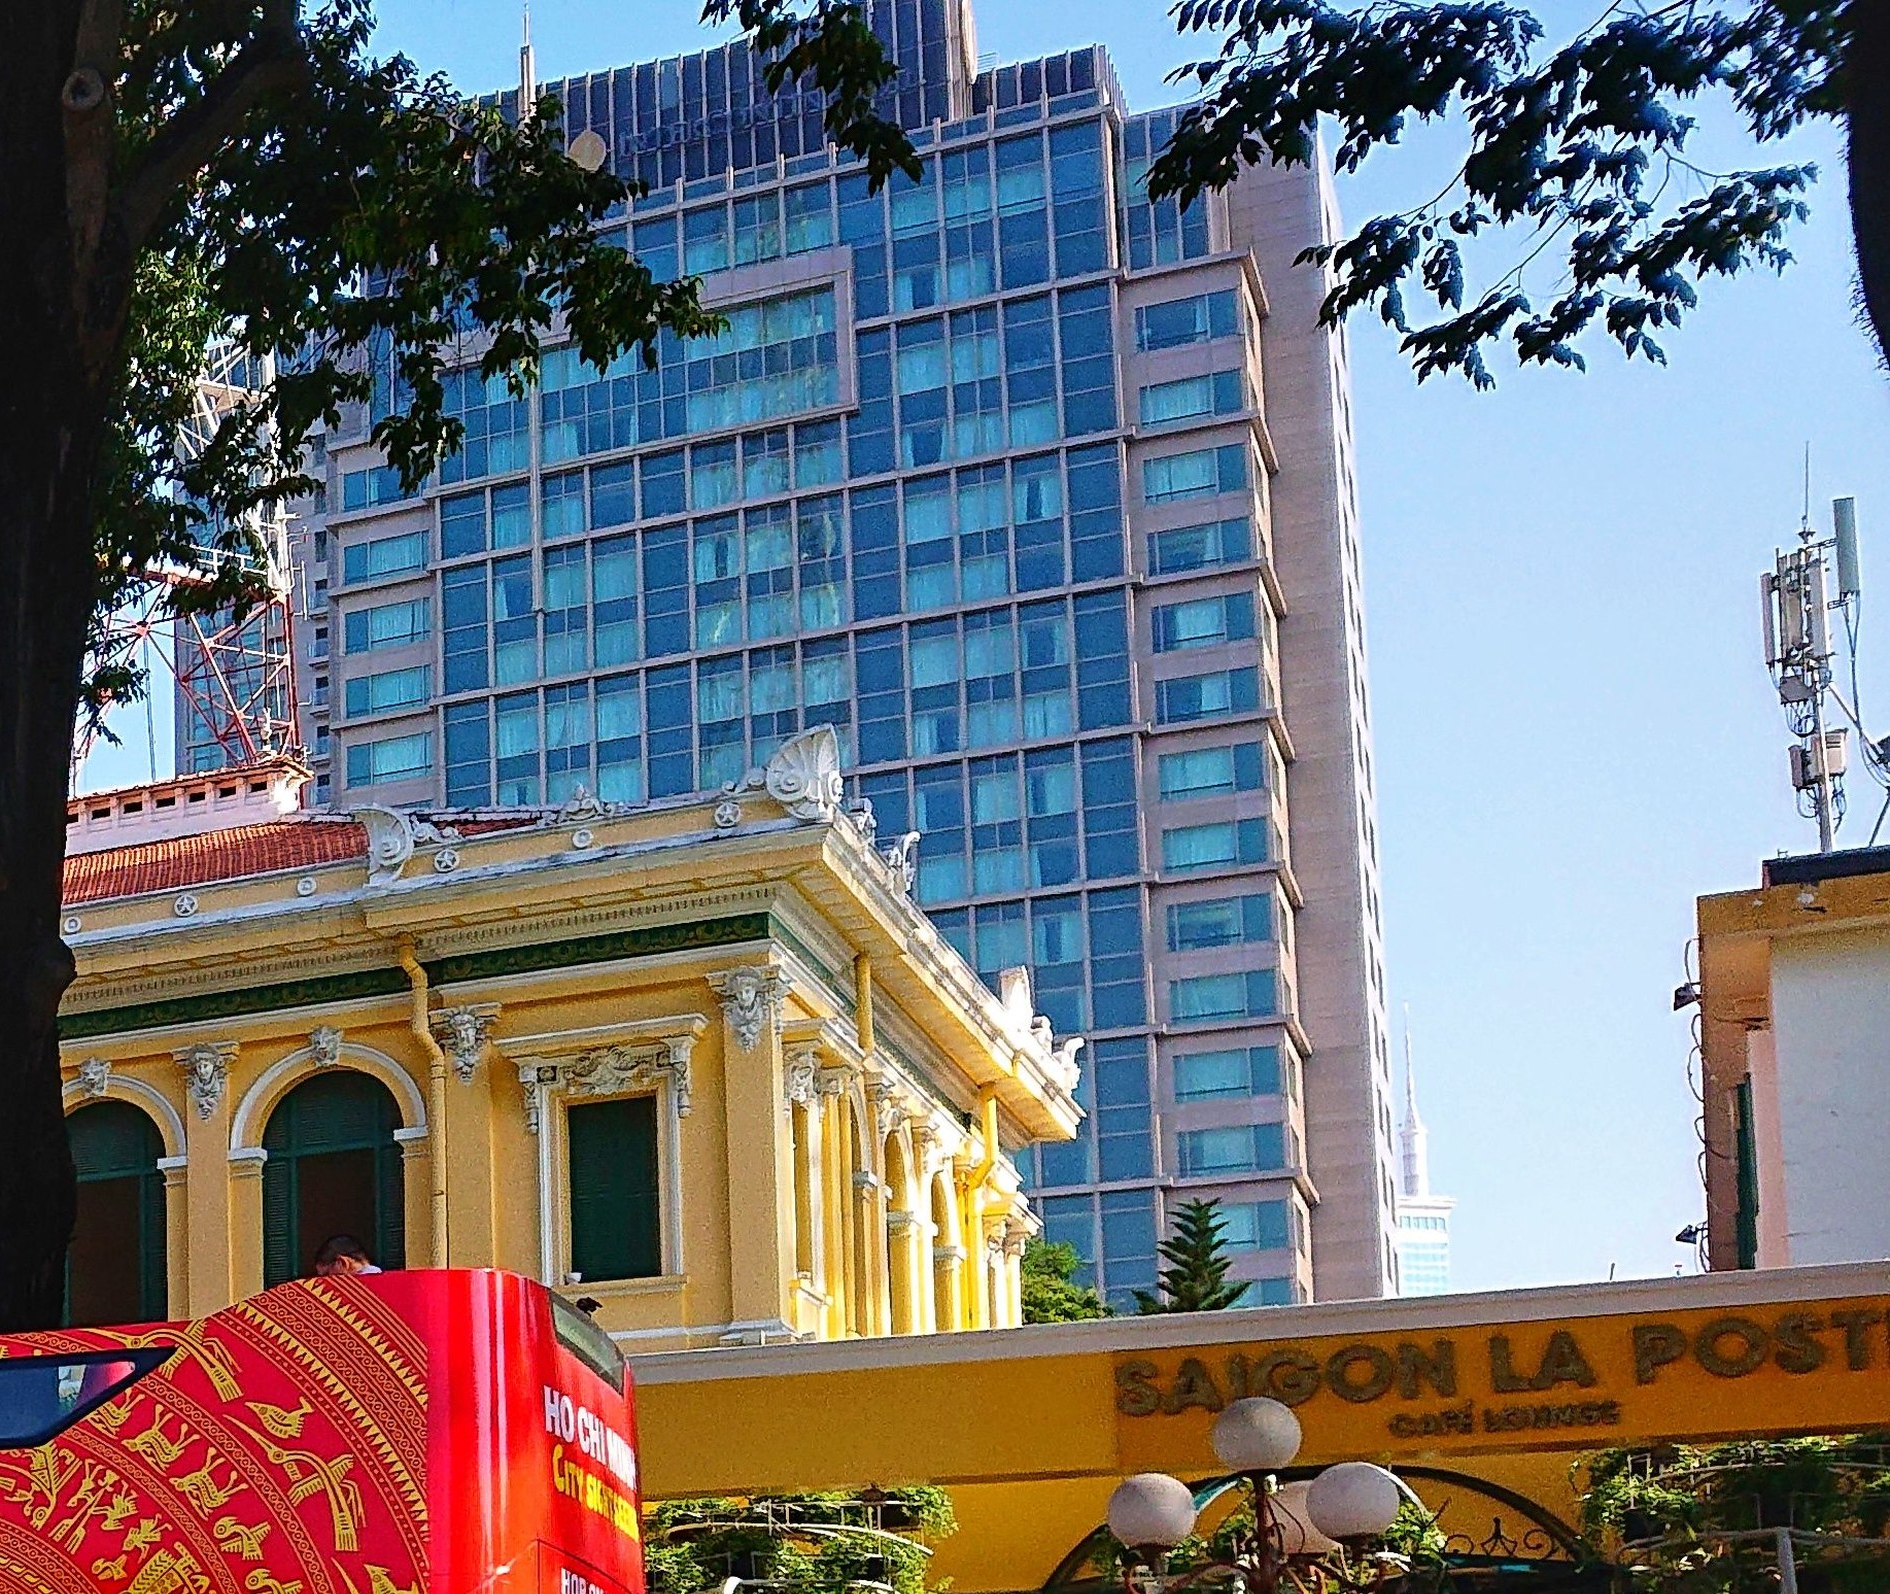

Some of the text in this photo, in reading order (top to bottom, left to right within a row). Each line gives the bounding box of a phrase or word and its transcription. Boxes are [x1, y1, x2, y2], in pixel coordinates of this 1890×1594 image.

[1115, 1308, 1890, 1416] SAIGON LA POST
[543, 1384, 575, 1443] HO
[577, 1406, 607, 1466] CHI
[1483, 1400, 1620, 1432] LOUNGE
